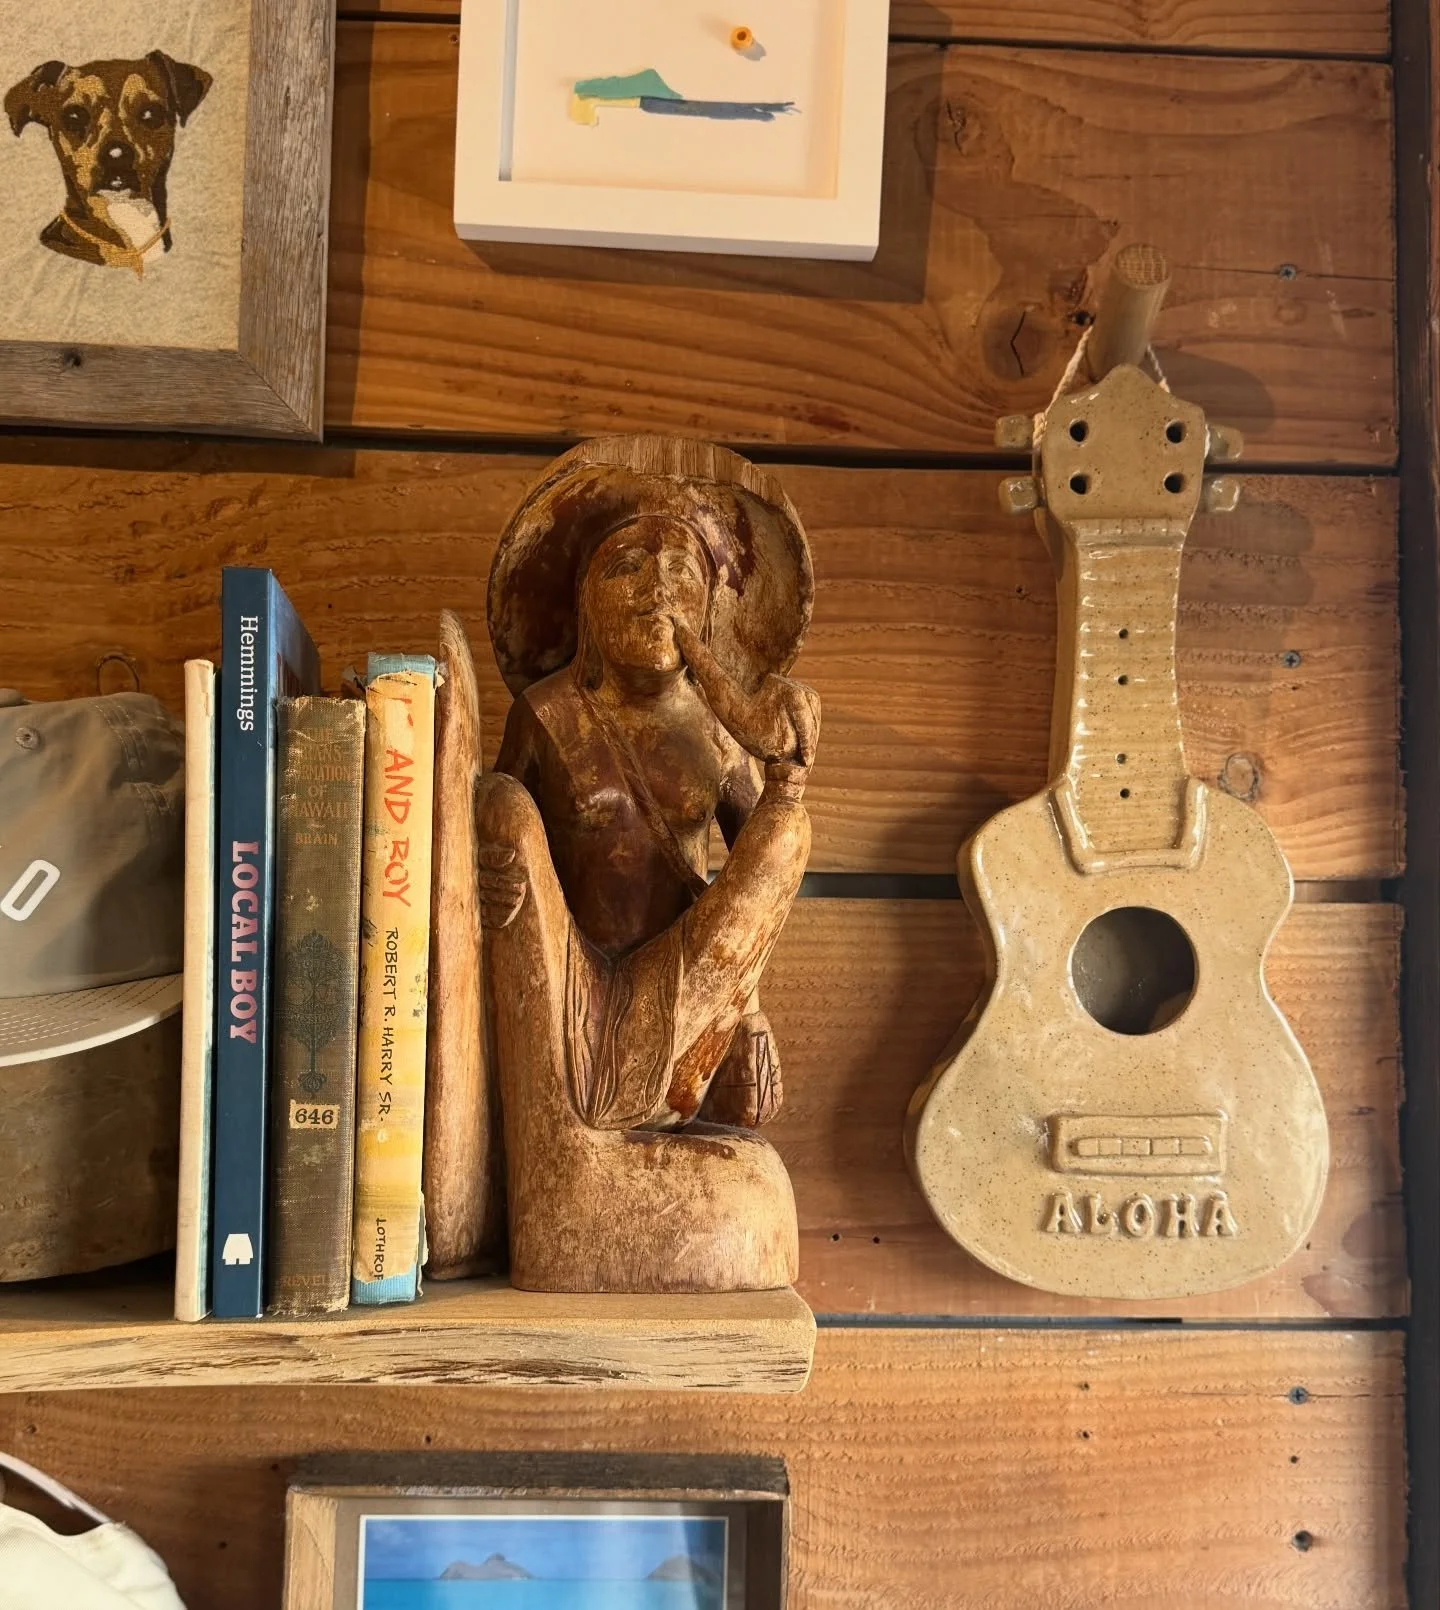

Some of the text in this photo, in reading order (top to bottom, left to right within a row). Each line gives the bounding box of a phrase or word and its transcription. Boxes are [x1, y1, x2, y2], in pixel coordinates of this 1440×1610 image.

[236, 615, 259, 731] Hemmings
[294, 744, 351, 762] RANS-
[306, 784, 329, 799] OF
[295, 832, 338, 846] BRAIN
[230, 841, 259, 1044] LOCAL BOY
[377, 927, 400, 1122] ROBERT R. HARRY SR.
[295, 1109, 334, 1125] 646
[1042, 1188, 1238, 1238] ALOHA
[280, 1273, 334, 1286] REVEL
